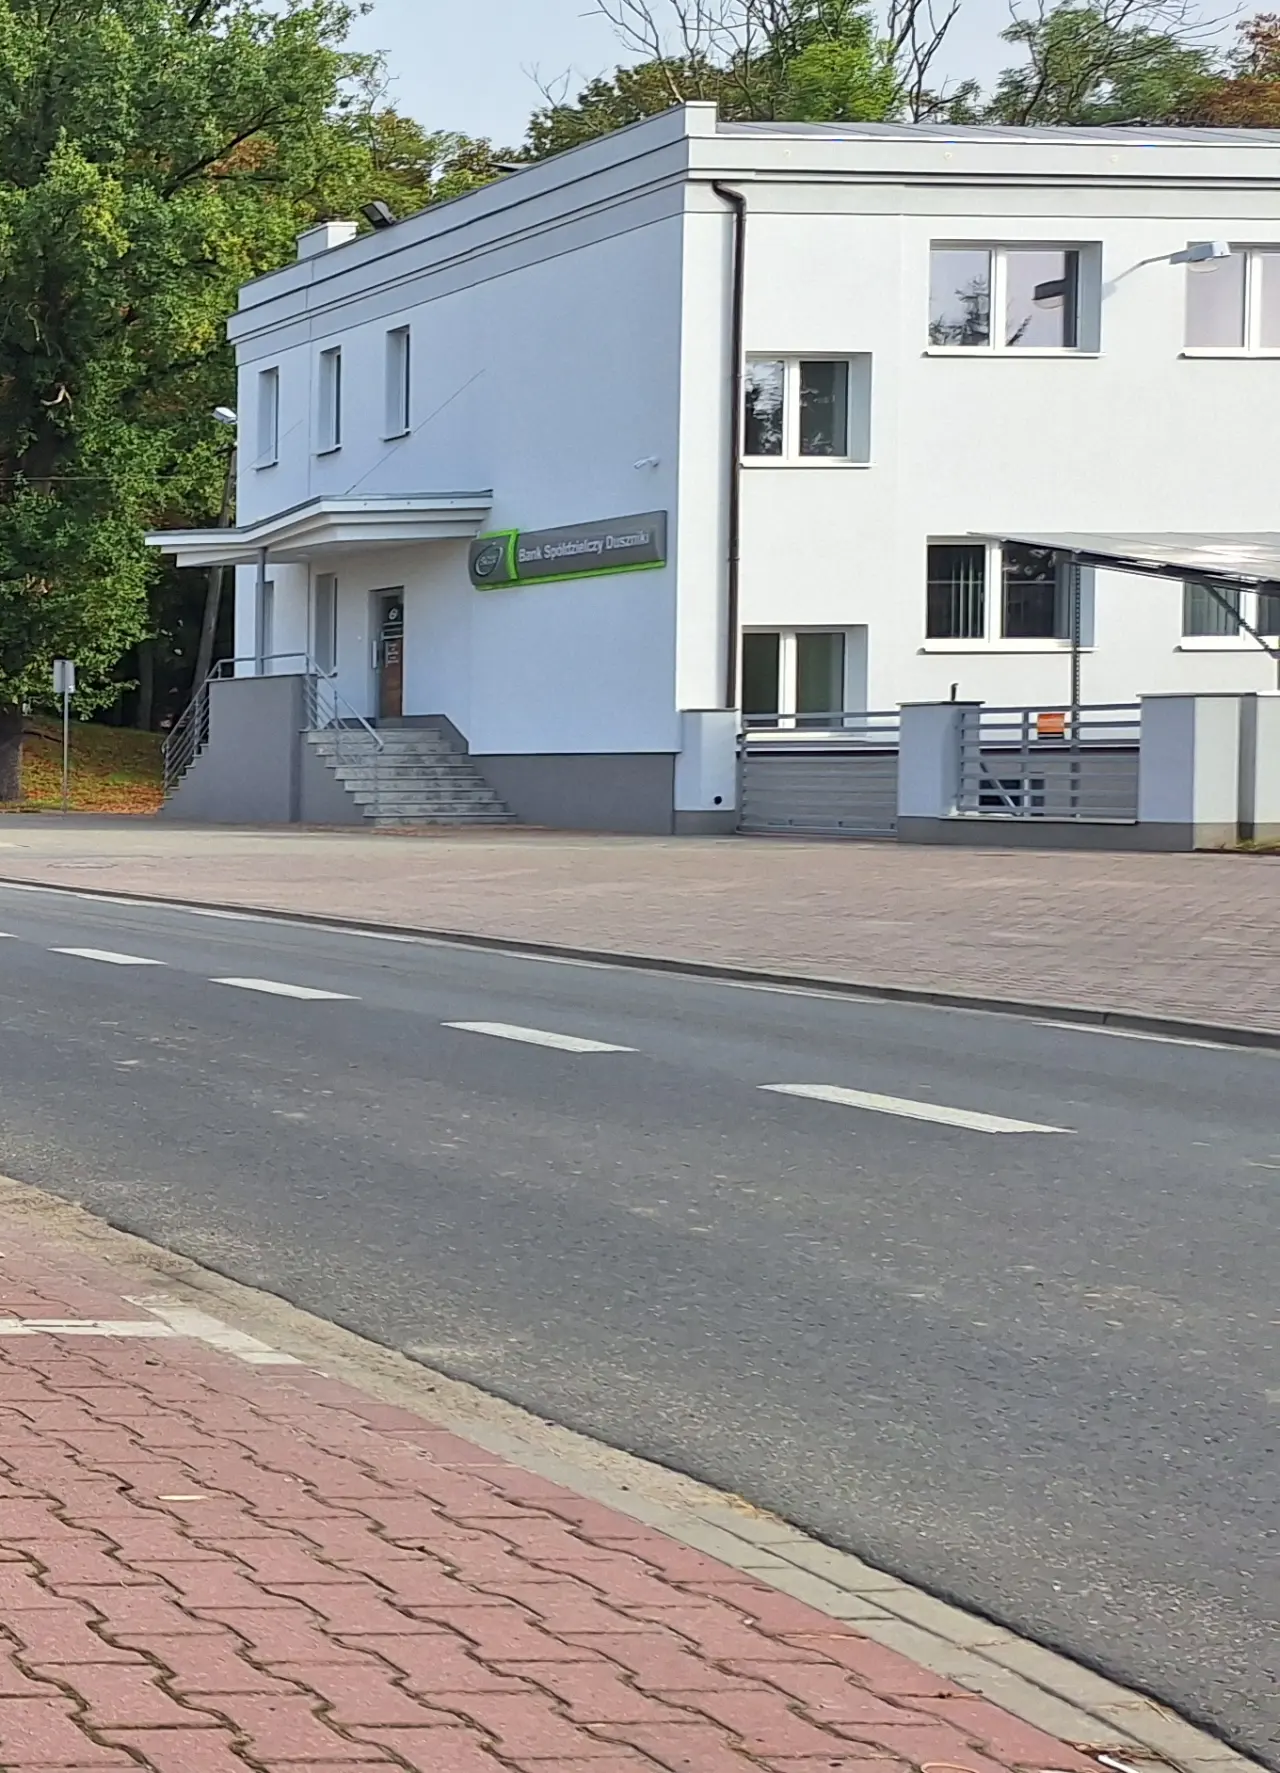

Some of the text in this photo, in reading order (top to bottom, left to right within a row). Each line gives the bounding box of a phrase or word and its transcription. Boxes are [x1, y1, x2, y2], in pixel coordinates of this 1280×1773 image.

[518, 546, 542, 563] Bank
[543, 539, 603, 561] Spółdzielczy
[605, 530, 650, 549] Duszniki
